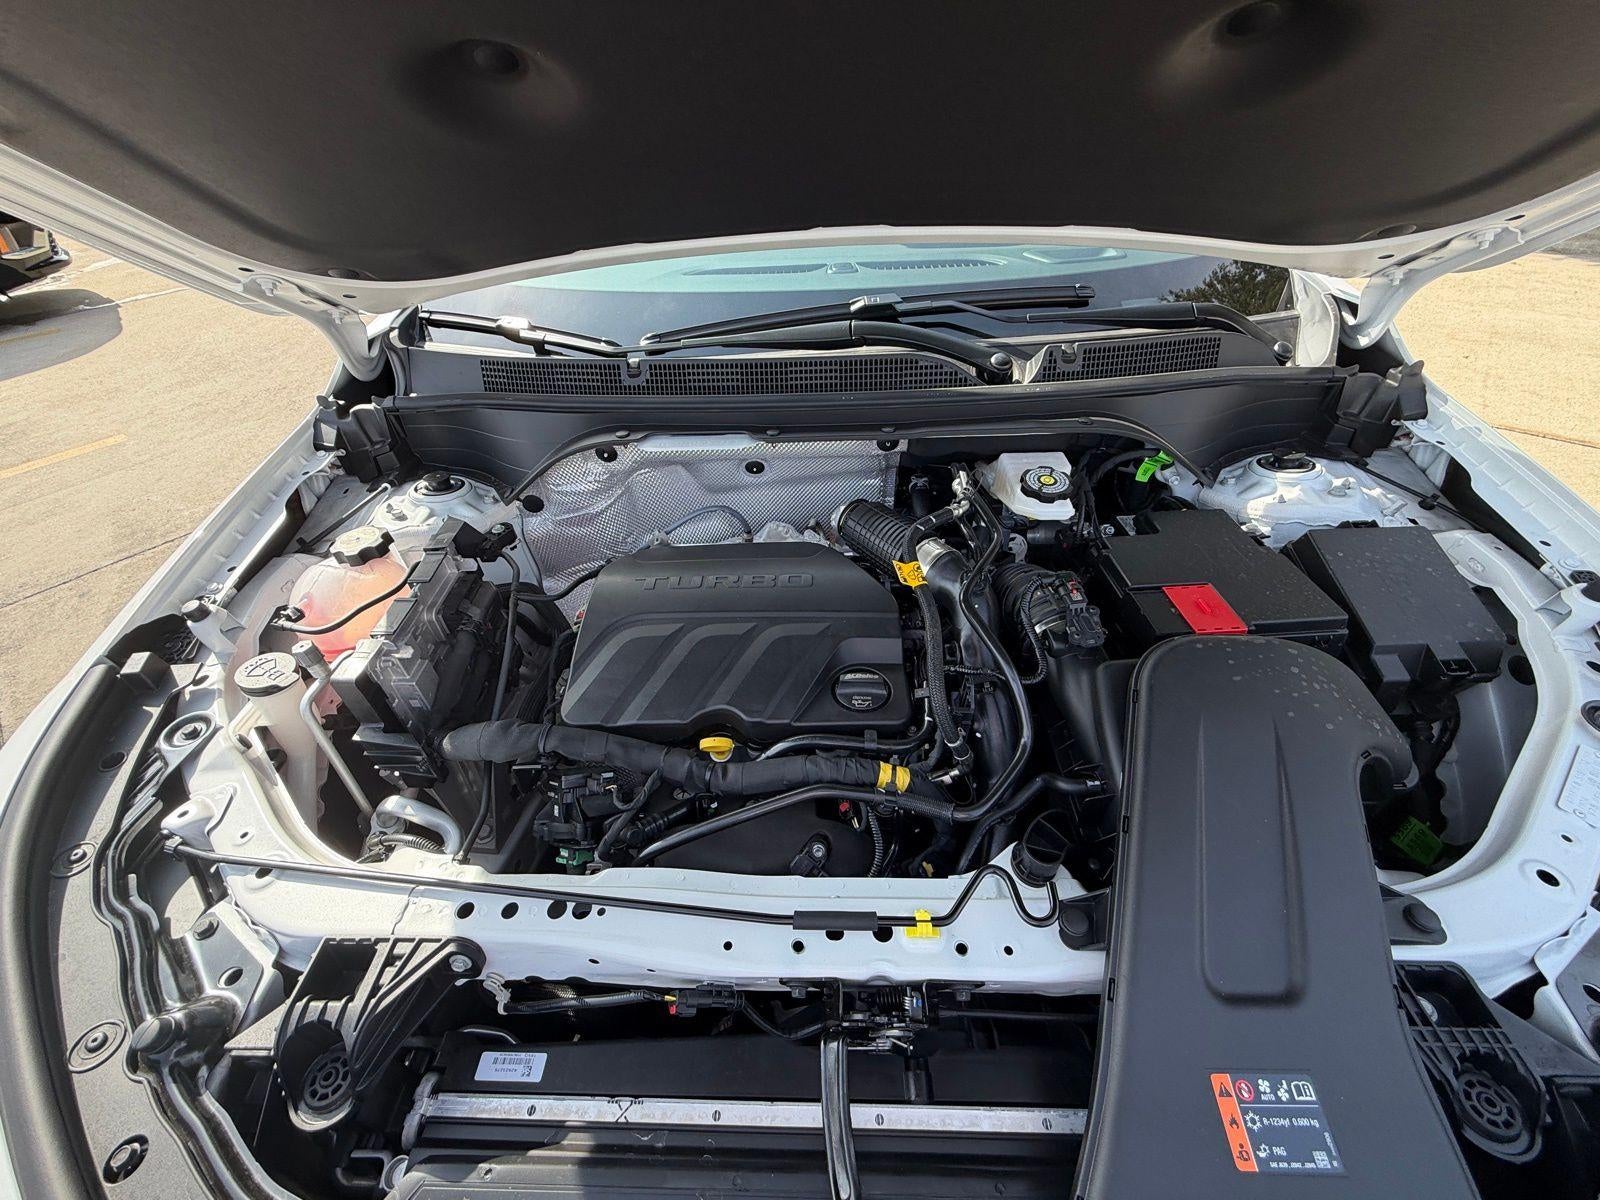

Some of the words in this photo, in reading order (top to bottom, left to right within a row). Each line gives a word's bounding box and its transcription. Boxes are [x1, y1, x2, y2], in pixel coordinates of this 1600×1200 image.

[635, 573, 815, 591] TURBO
[1310, 1118, 1319, 1127] kg
[1272, 1146, 1287, 1156] PAG
